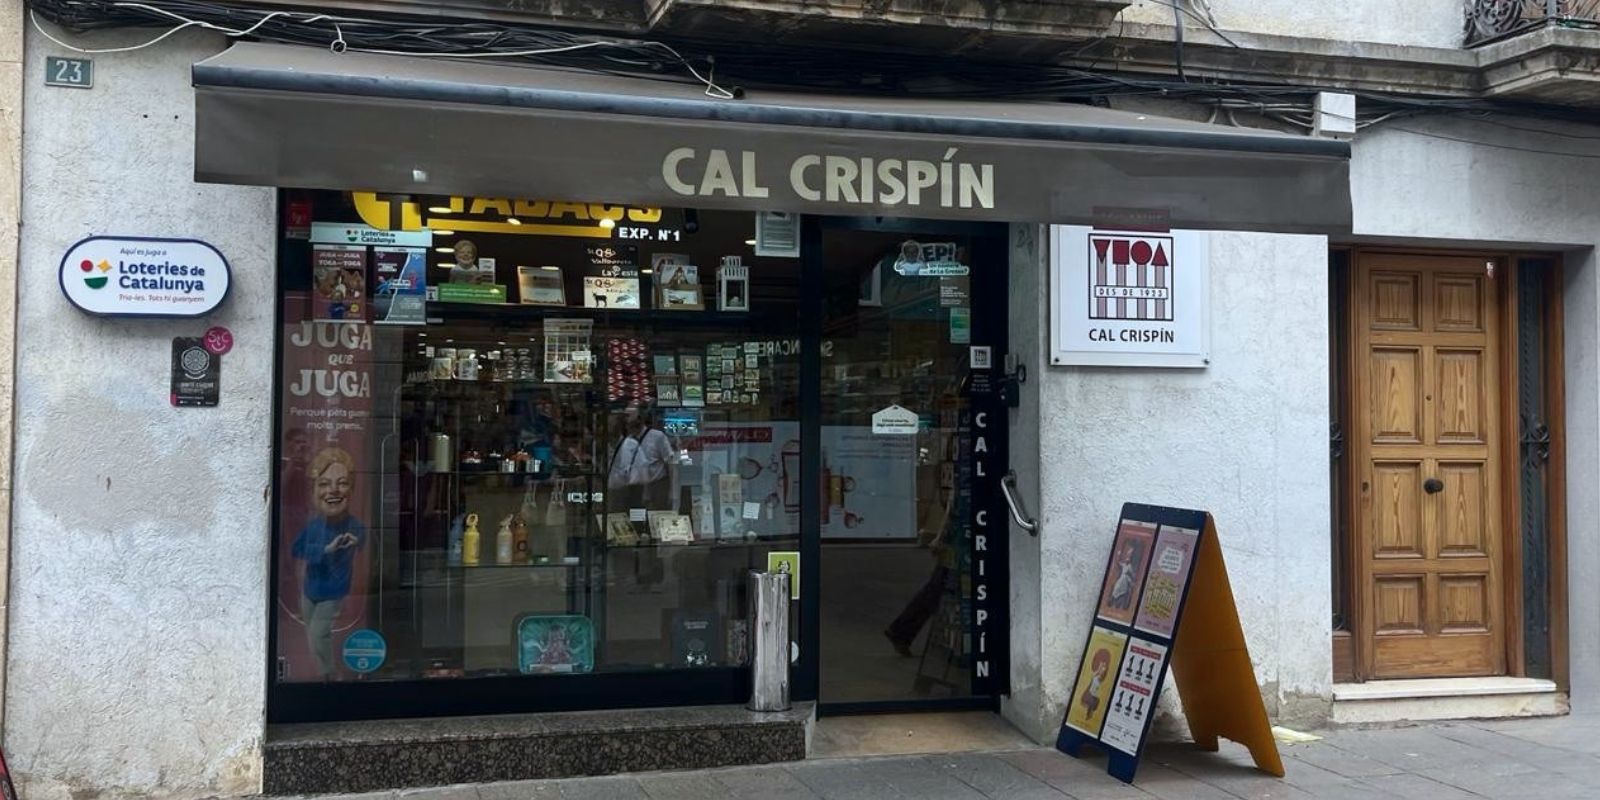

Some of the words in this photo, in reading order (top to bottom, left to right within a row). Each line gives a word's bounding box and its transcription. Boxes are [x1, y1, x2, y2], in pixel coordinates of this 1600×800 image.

[55, 60, 82, 83] 23
[662, 147, 769, 199] CAL
[790, 147, 995, 209] CRISPÍN
[619, 227, 653, 240] EXP.
[119, 261, 188, 276] Loteries
[190, 266, 205, 276] de
[119, 275, 205, 294] Catalunya
[1099, 287, 1117, 296] DES
[1123, 288, 1134, 297] DE
[291, 320, 372, 350] JUGA
[1089, 328, 1116, 342] CAL
[1120, 327, 1174, 343] CRISPÍN
[328, 353, 354, 366] QUE
[290, 369, 370, 398] JUGA
[975, 412, 987, 477] CAL
[975, 511, 989, 677] CRISPÍN
